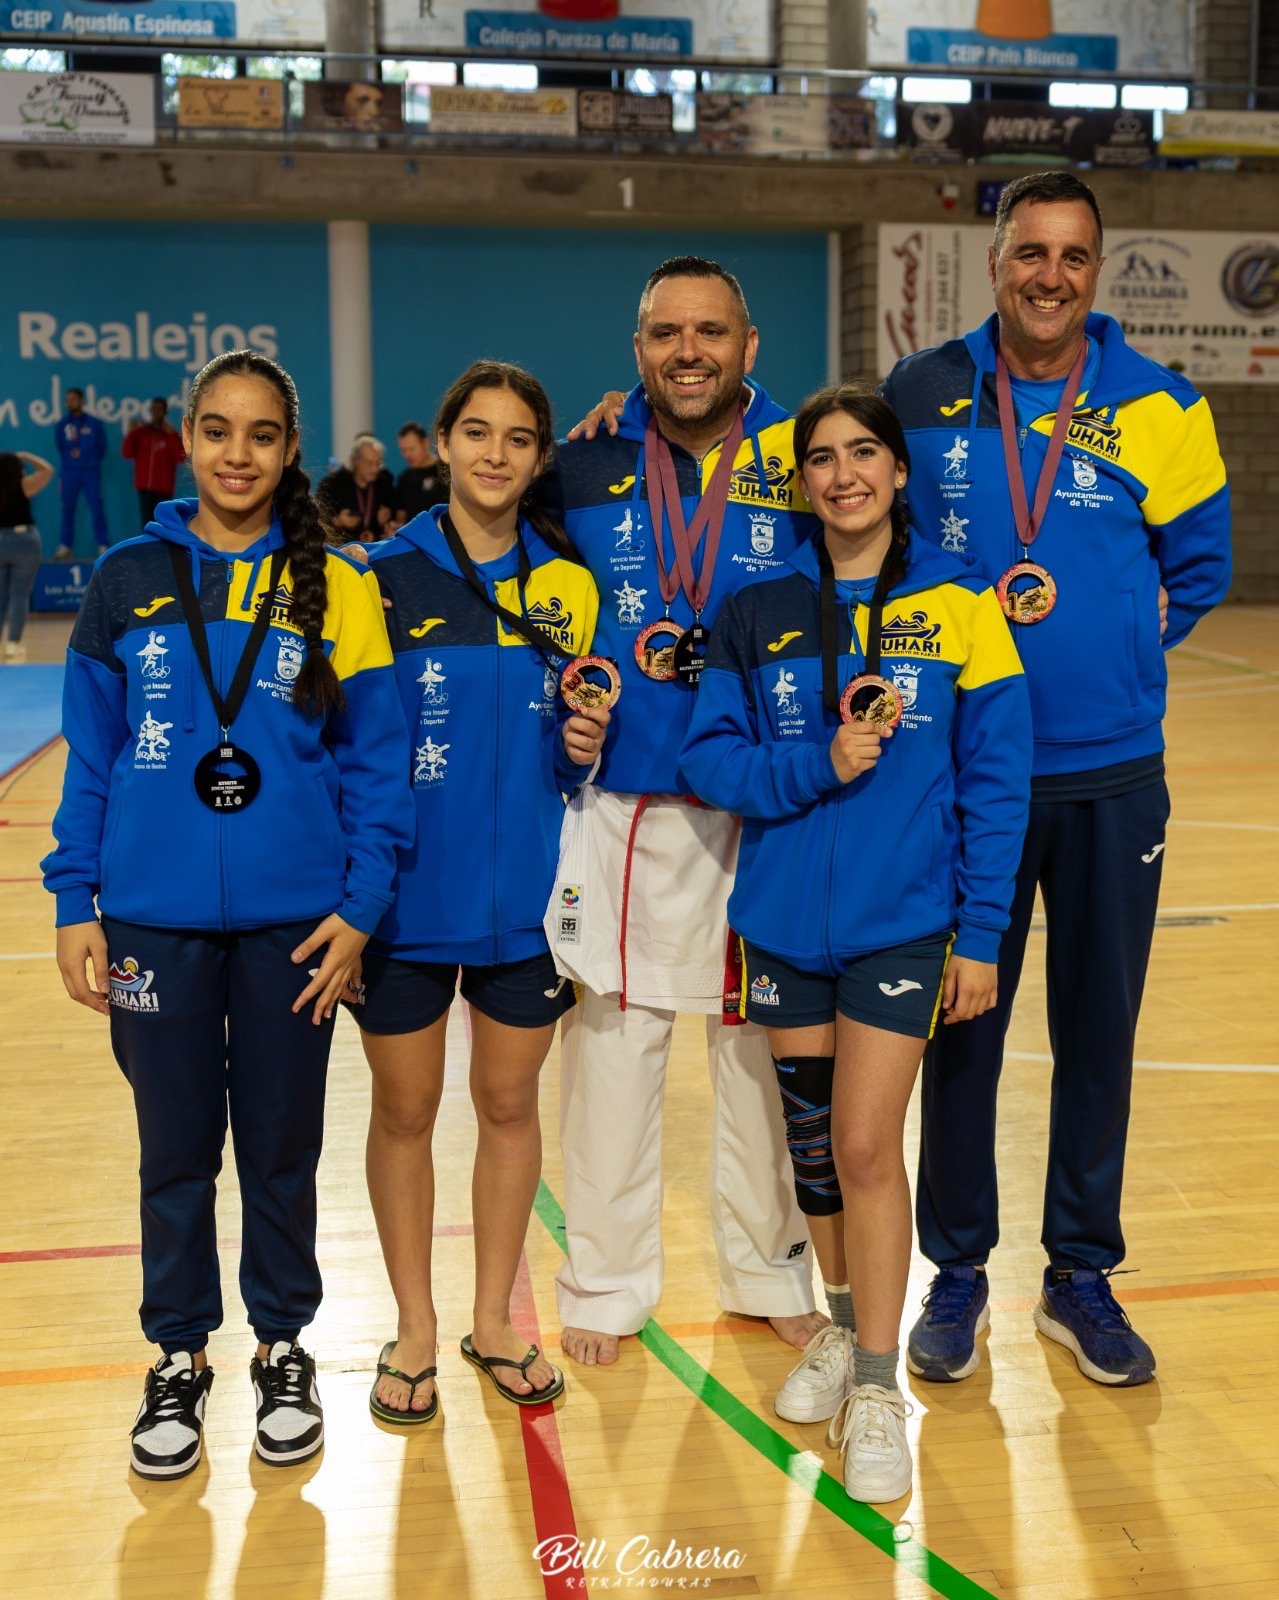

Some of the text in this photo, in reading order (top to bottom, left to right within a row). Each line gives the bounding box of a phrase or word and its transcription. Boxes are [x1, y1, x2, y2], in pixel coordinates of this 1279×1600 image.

[11, 10, 215, 36] CEIP Agustín Espinosa
[479, 27, 543, 49] Colegio
[546, 29, 602, 48] Pureza
[607, 30, 628, 49] de
[632, 32, 680, 51] María
[948, 45, 984, 64] CEIP
[1024, 49, 1078, 68] Blanco
[618, 177, 634, 209] 1
[19, 311, 279, 372] Realejos
[1067, 423, 1122, 458] UHARI
[728, 481, 793, 503] SUHARI
[1054, 489, 1114, 502] Ayuntamiento
[1069, 499, 1080, 507] de
[731, 553, 784, 567] Ayuntamien
[69, 564, 81, 586] 1
[1008, 592, 1018, 612] 1
[538, 624, 574, 645] HARI
[881, 638, 941, 653] UHARI
[901, 713, 933, 722] miento
[750, 990, 780, 1004] SUHARI
